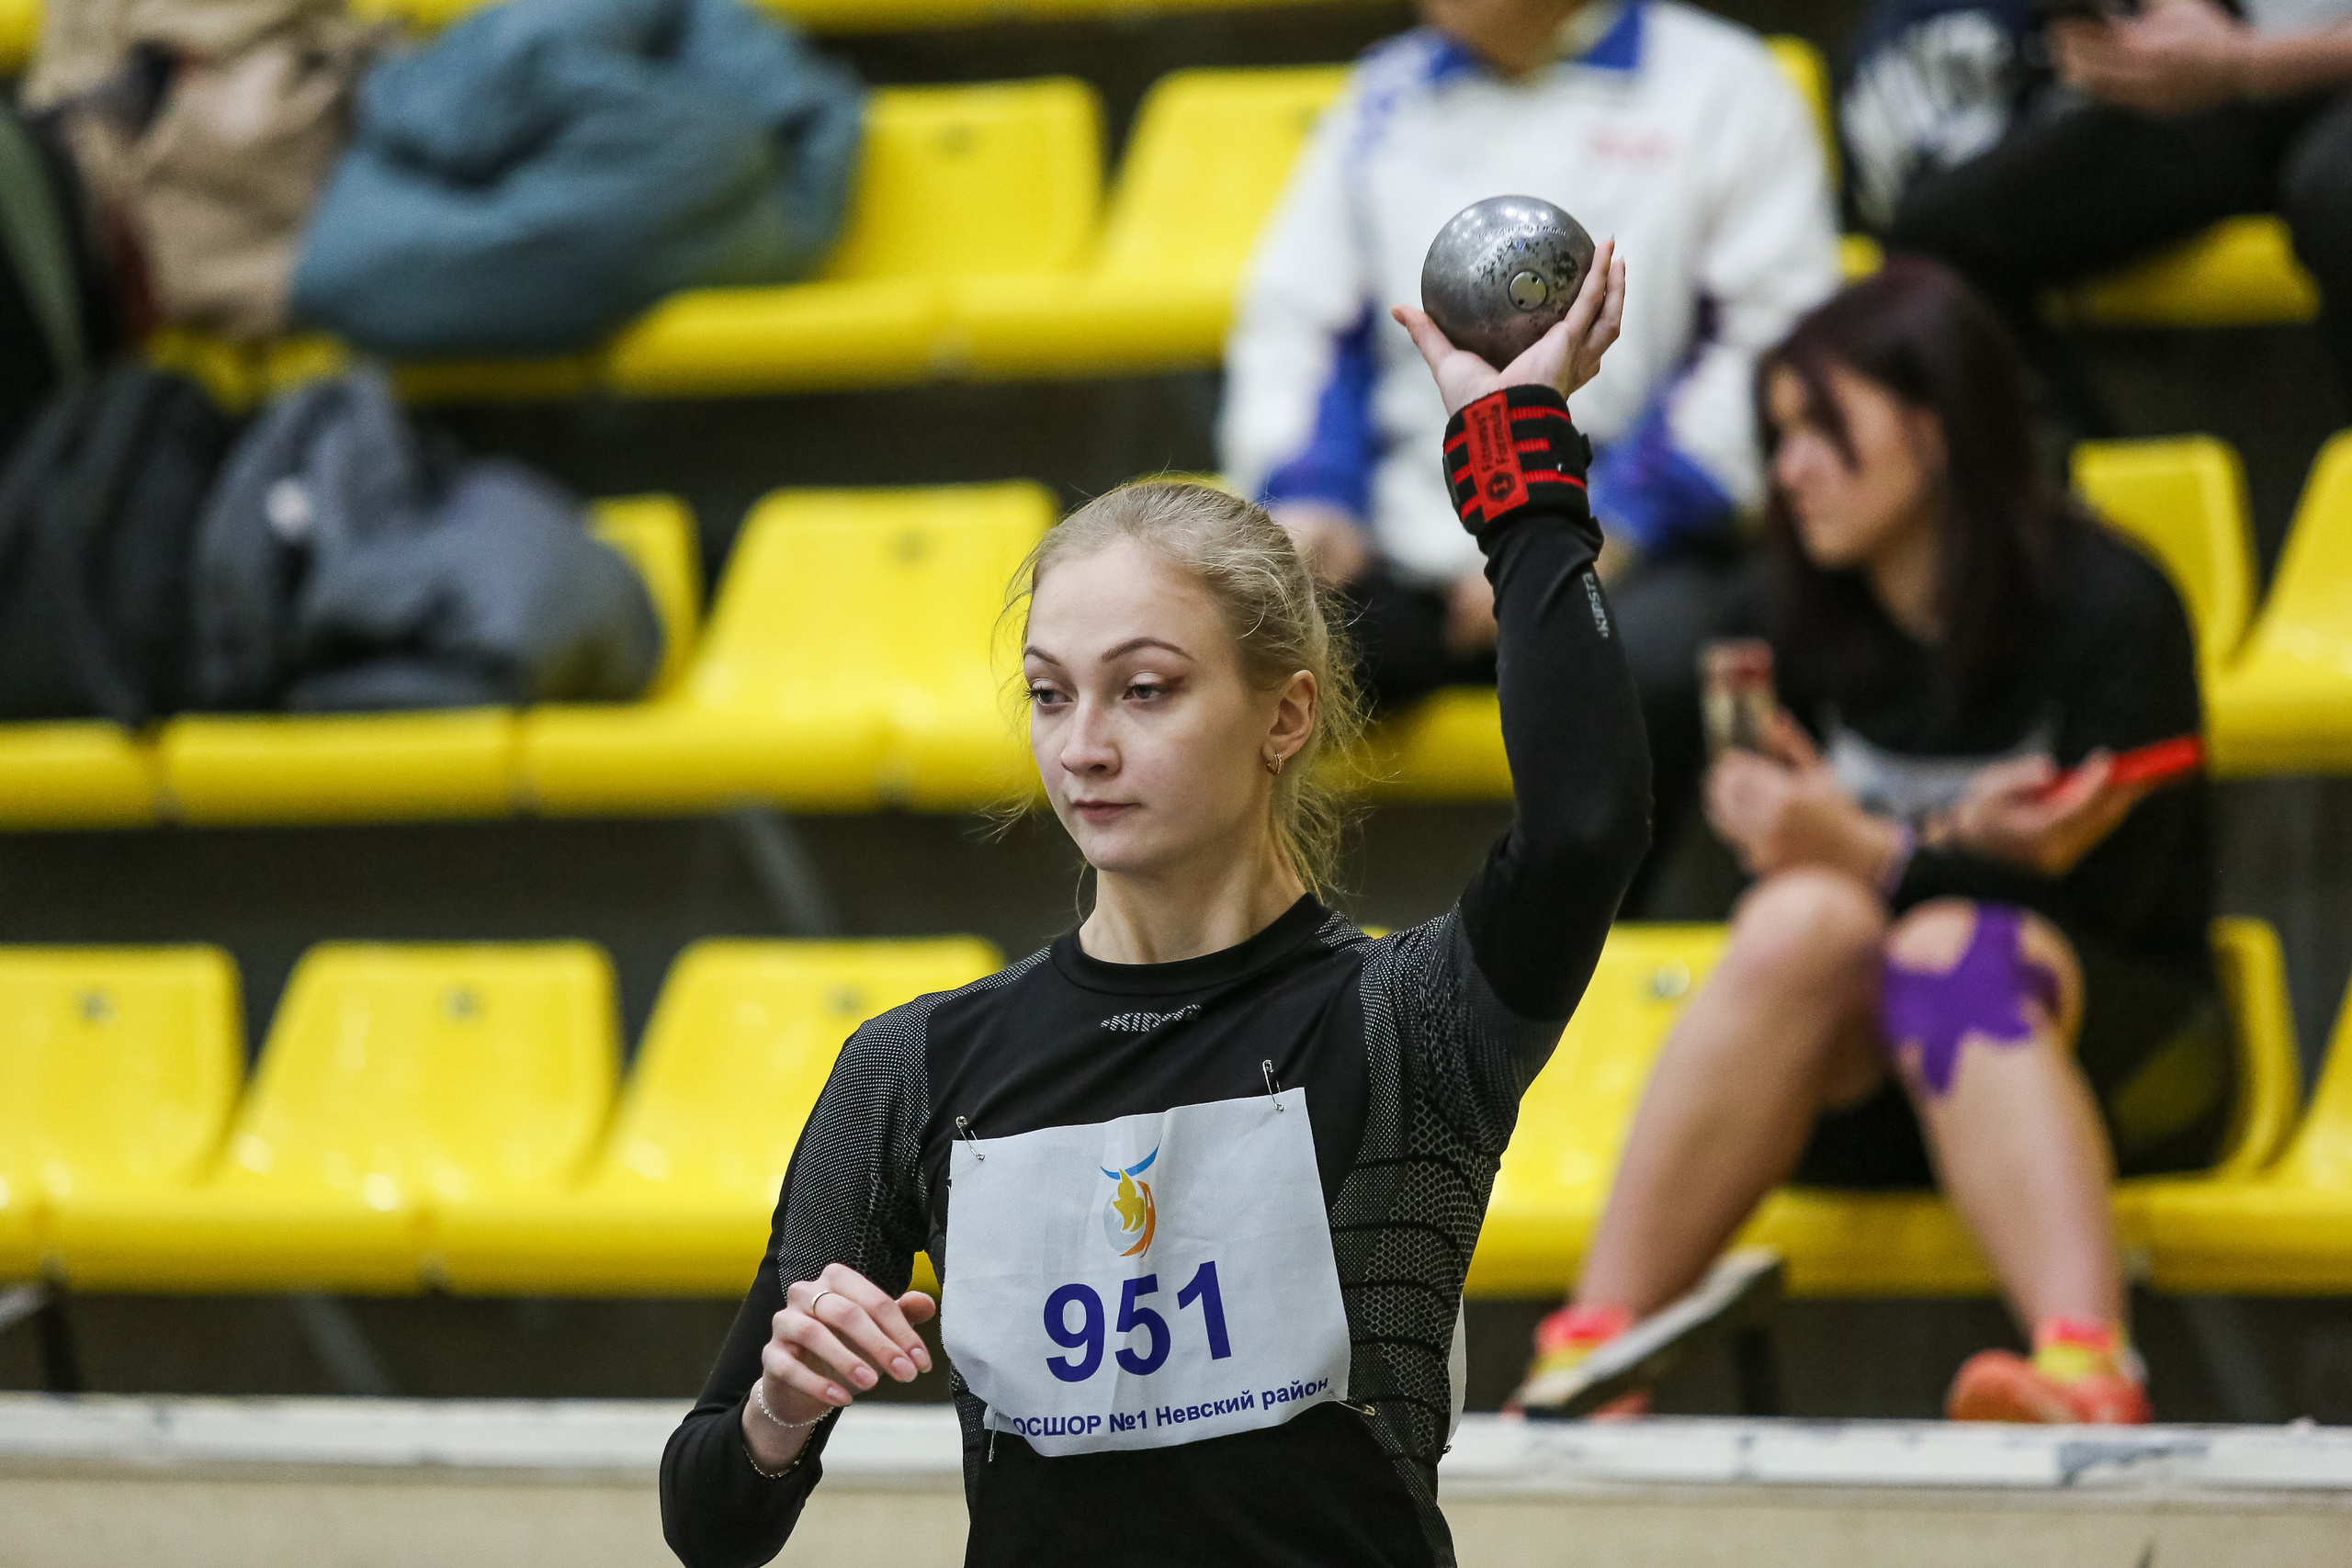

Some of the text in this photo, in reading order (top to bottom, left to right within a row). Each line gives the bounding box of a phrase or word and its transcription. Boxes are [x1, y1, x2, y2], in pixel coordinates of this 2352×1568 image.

[1043, 1260, 1232, 1382] 951
[1109, 1410, 1148, 1433] №1
[1155, 1390, 1255, 1427] Невский
[1261, 1377, 1329, 1411] район
